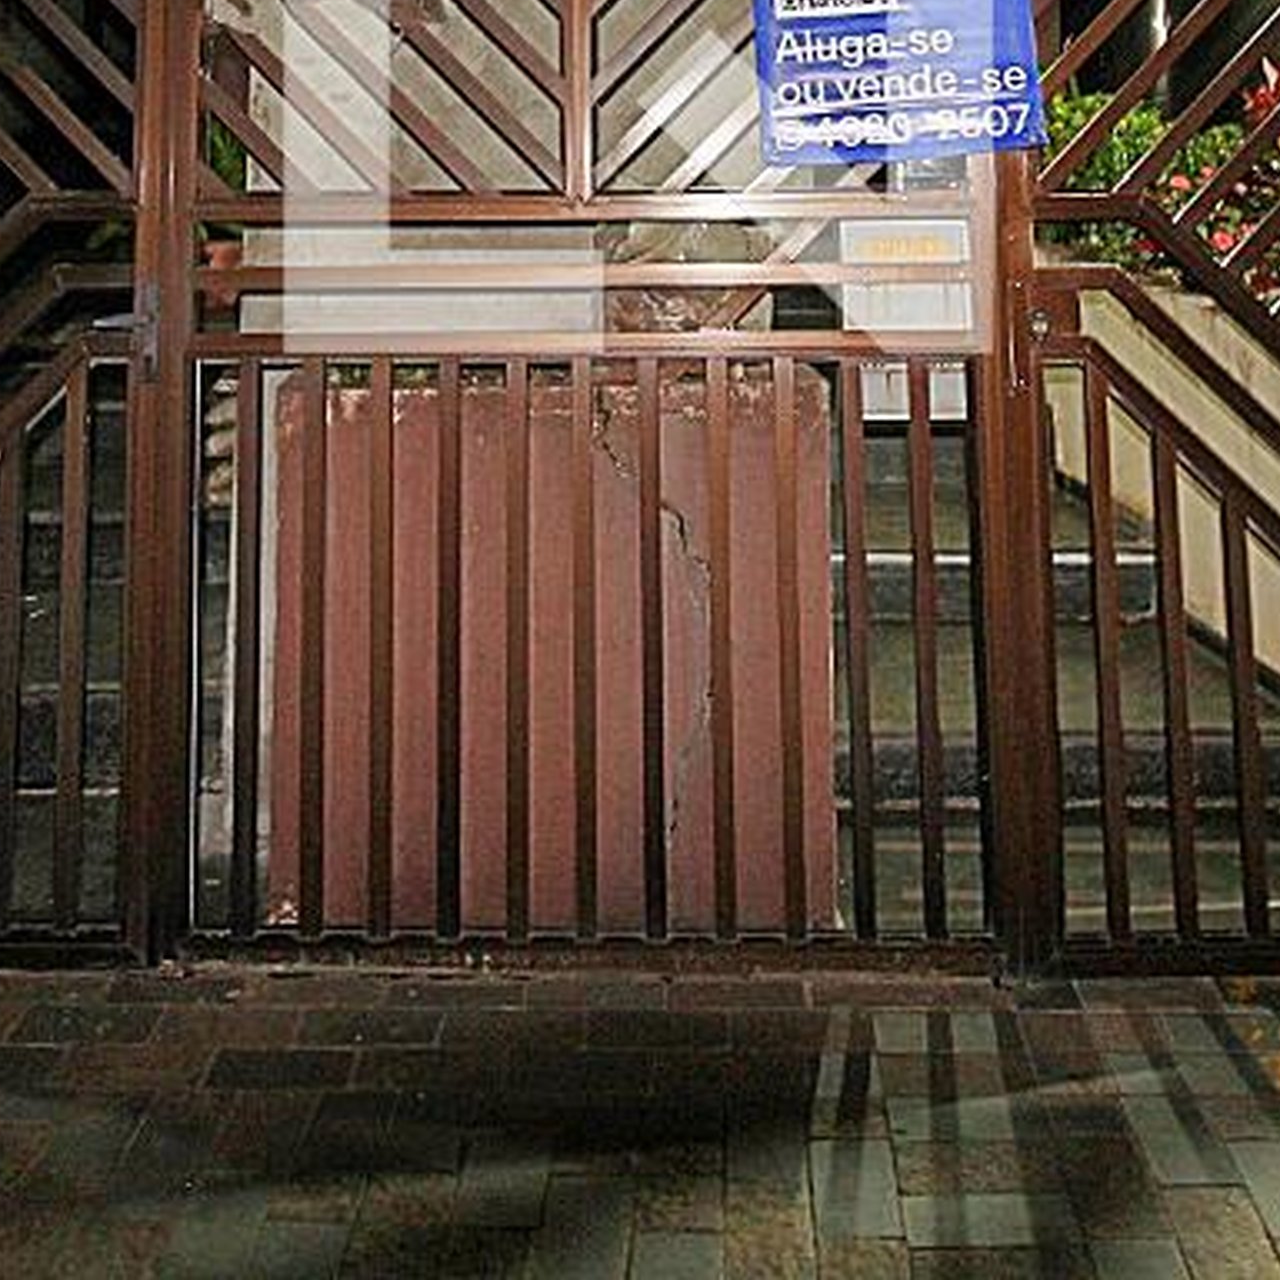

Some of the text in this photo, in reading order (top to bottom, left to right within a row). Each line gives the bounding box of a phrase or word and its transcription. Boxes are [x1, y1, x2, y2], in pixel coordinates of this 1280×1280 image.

[776, 28, 954, 68] Aluga-se
[778, 63, 1028, 106] ou vende-se
